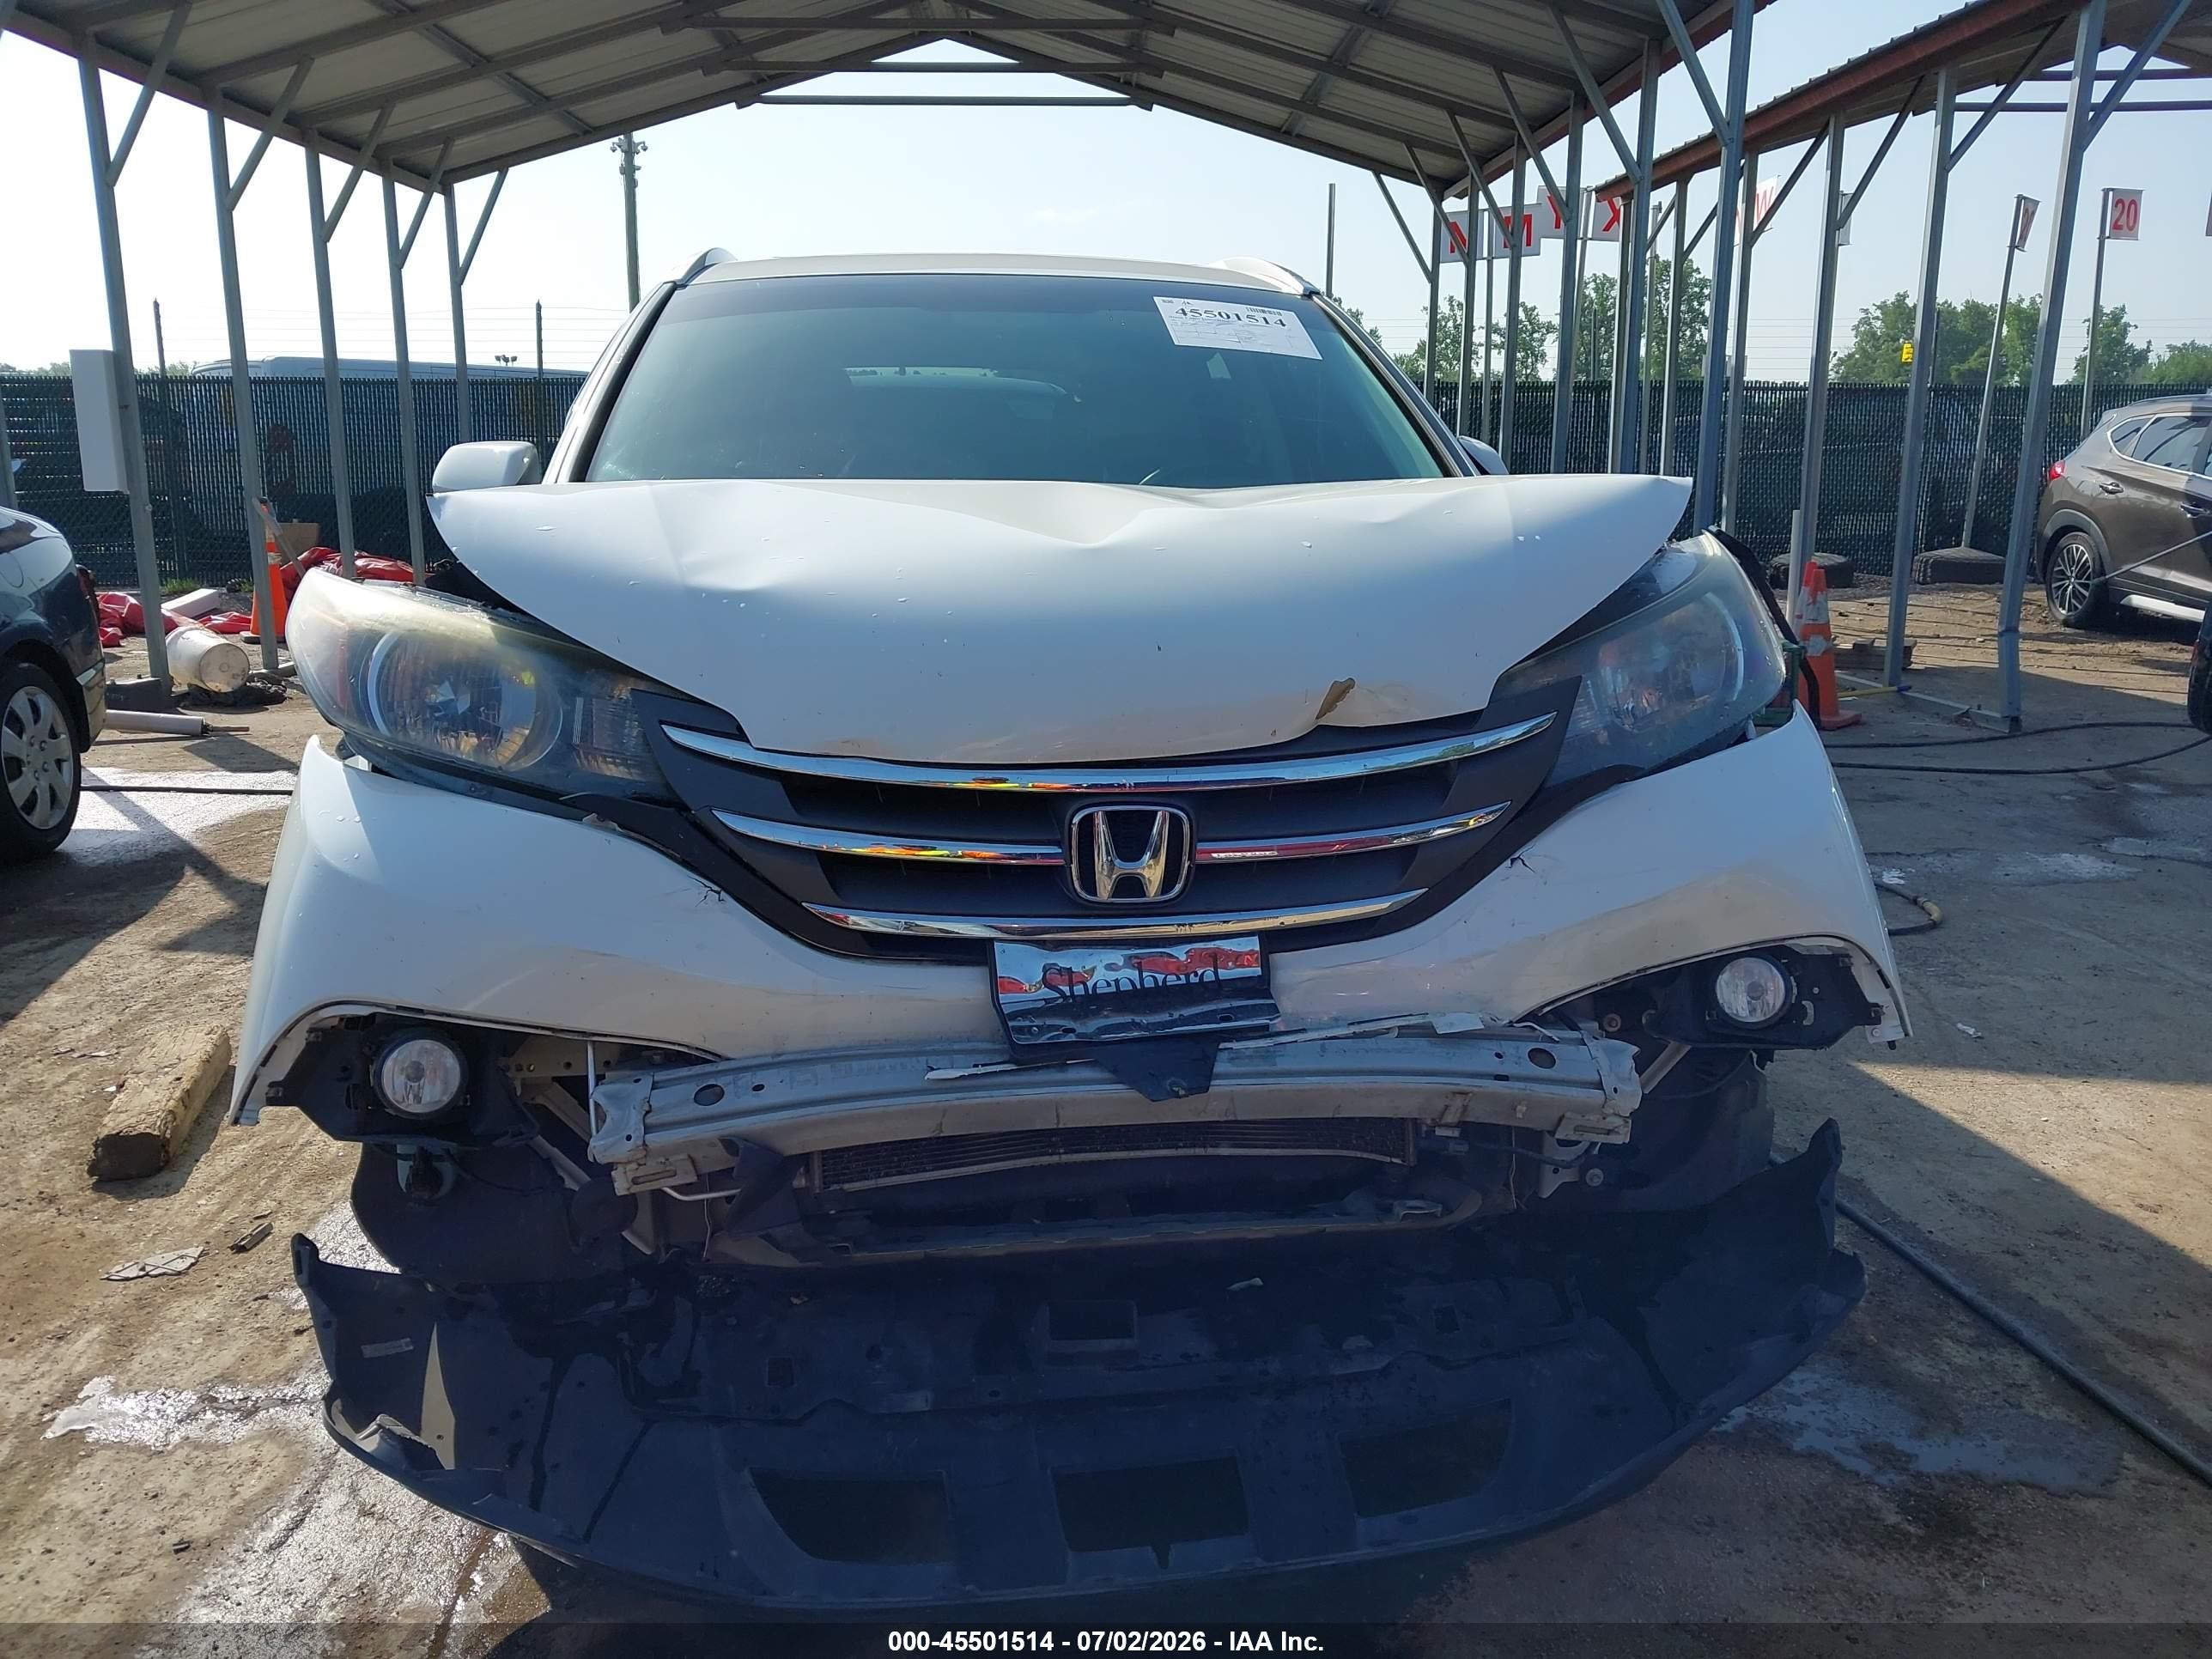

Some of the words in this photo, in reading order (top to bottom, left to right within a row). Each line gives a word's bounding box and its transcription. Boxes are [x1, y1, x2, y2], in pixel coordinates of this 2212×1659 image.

[2112, 198, 2138, 231] 20
[1175, 307, 1286, 327] 45501514
[1042, 952, 1221, 1002] Shepherd
